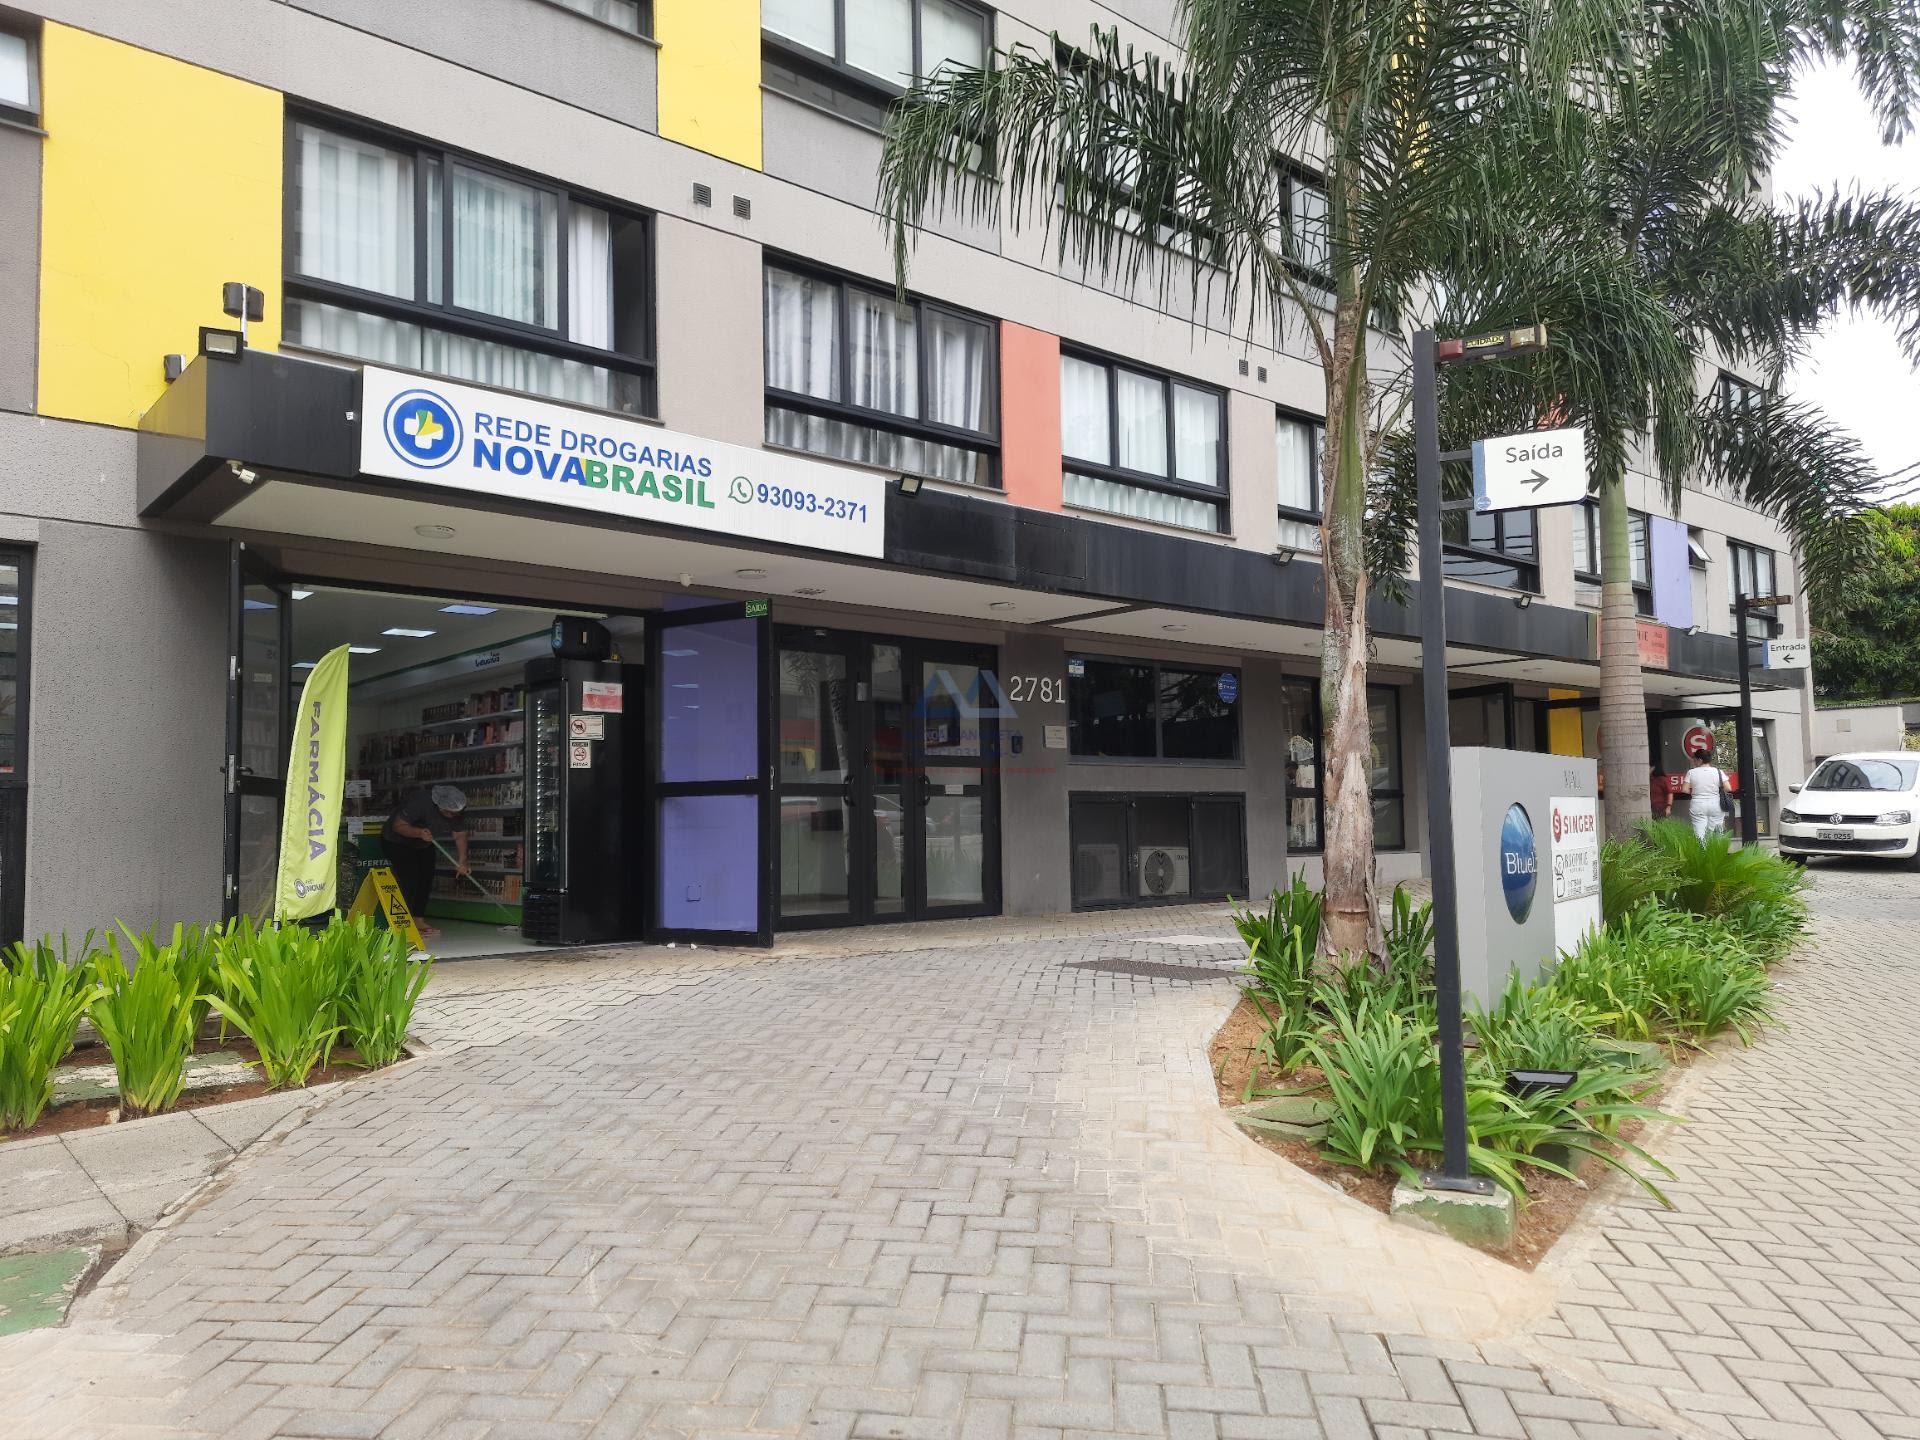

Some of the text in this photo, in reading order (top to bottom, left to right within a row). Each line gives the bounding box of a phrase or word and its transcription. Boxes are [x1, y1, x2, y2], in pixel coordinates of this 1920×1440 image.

[475, 412, 712, 478] REDE DROGARIAS
[1505, 443, 1563, 463] Saída
[757, 483, 867, 523] 93093-2371
[1770, 643, 1806, 652] Entrada
[1010, 675, 1066, 704] 2781
[307, 701, 327, 861] FARMÁCIA
[1563, 815, 1595, 834] SINGER
